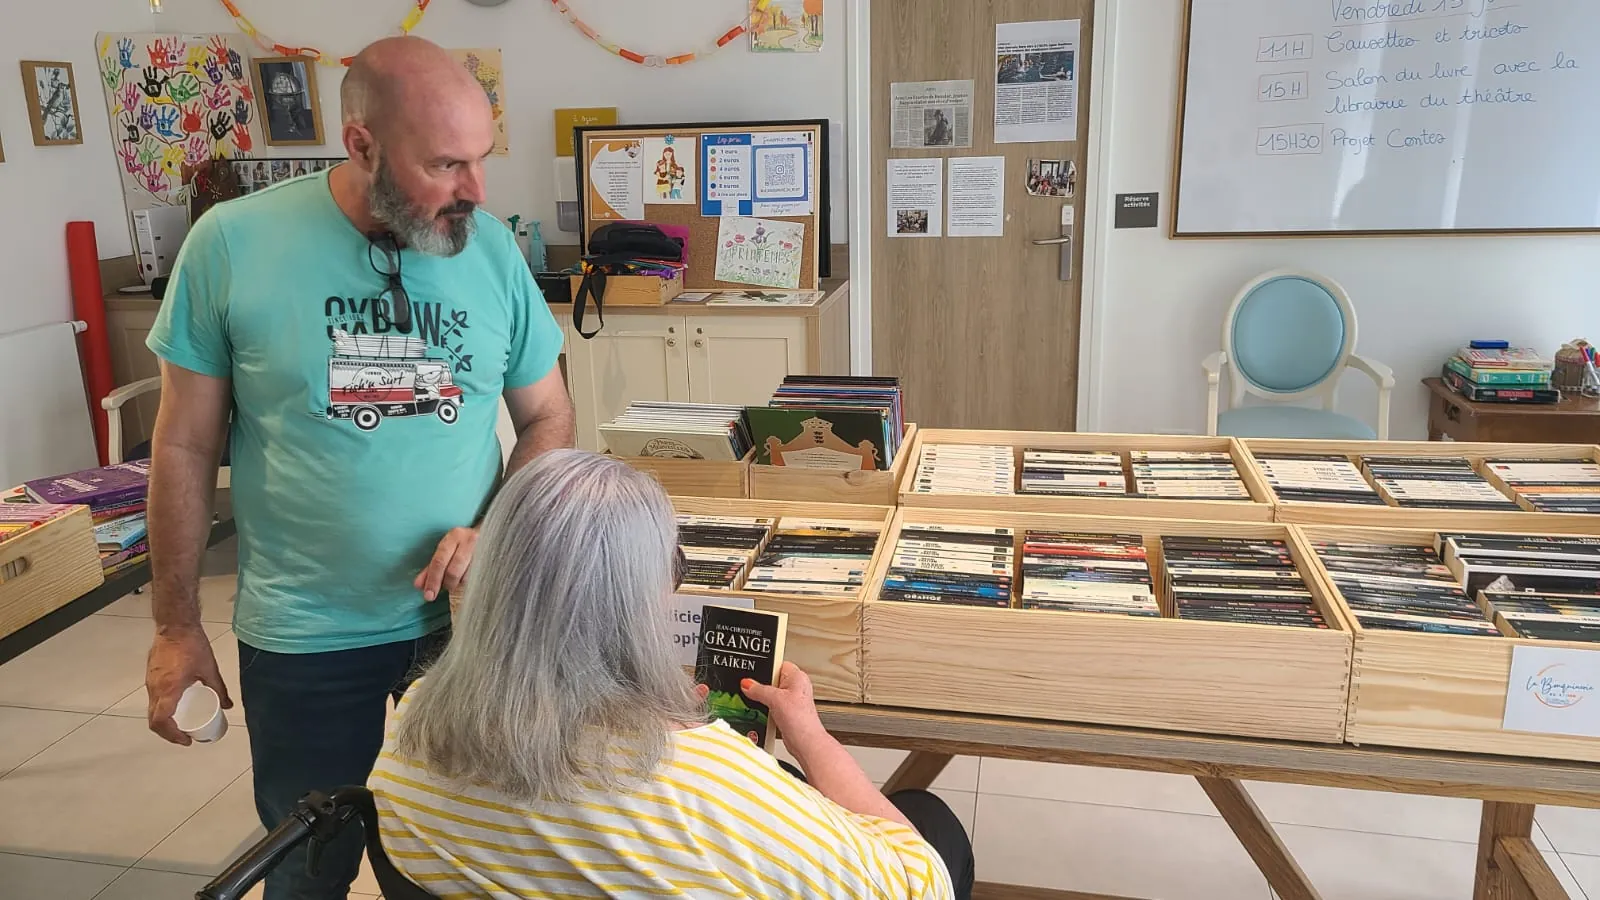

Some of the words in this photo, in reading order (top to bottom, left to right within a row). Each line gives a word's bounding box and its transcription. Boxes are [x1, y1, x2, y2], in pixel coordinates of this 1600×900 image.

[1261, 40, 1304, 57] 11H
[1435, 28, 1452, 44] et
[1459, 20, 1529, 42] tricots
[1325, 67, 1389, 90] Salon
[1395, 68, 1423, 82] du
[1429, 62, 1473, 79] livre
[1493, 61, 1541, 75] avec
[1551, 51, 1579, 69] la
[1419, 93, 1448, 108] du
[1456, 87, 1537, 104] théâtre
[1258, 132, 1321, 151] 15H30
[1330, 128, 1377, 155] Projet
[1386, 128, 1447, 148] Contes
[673, 631, 700, 648] oph
[705, 631, 771, 654] GRANGE
[713, 655, 756, 672] KAÏKEN
